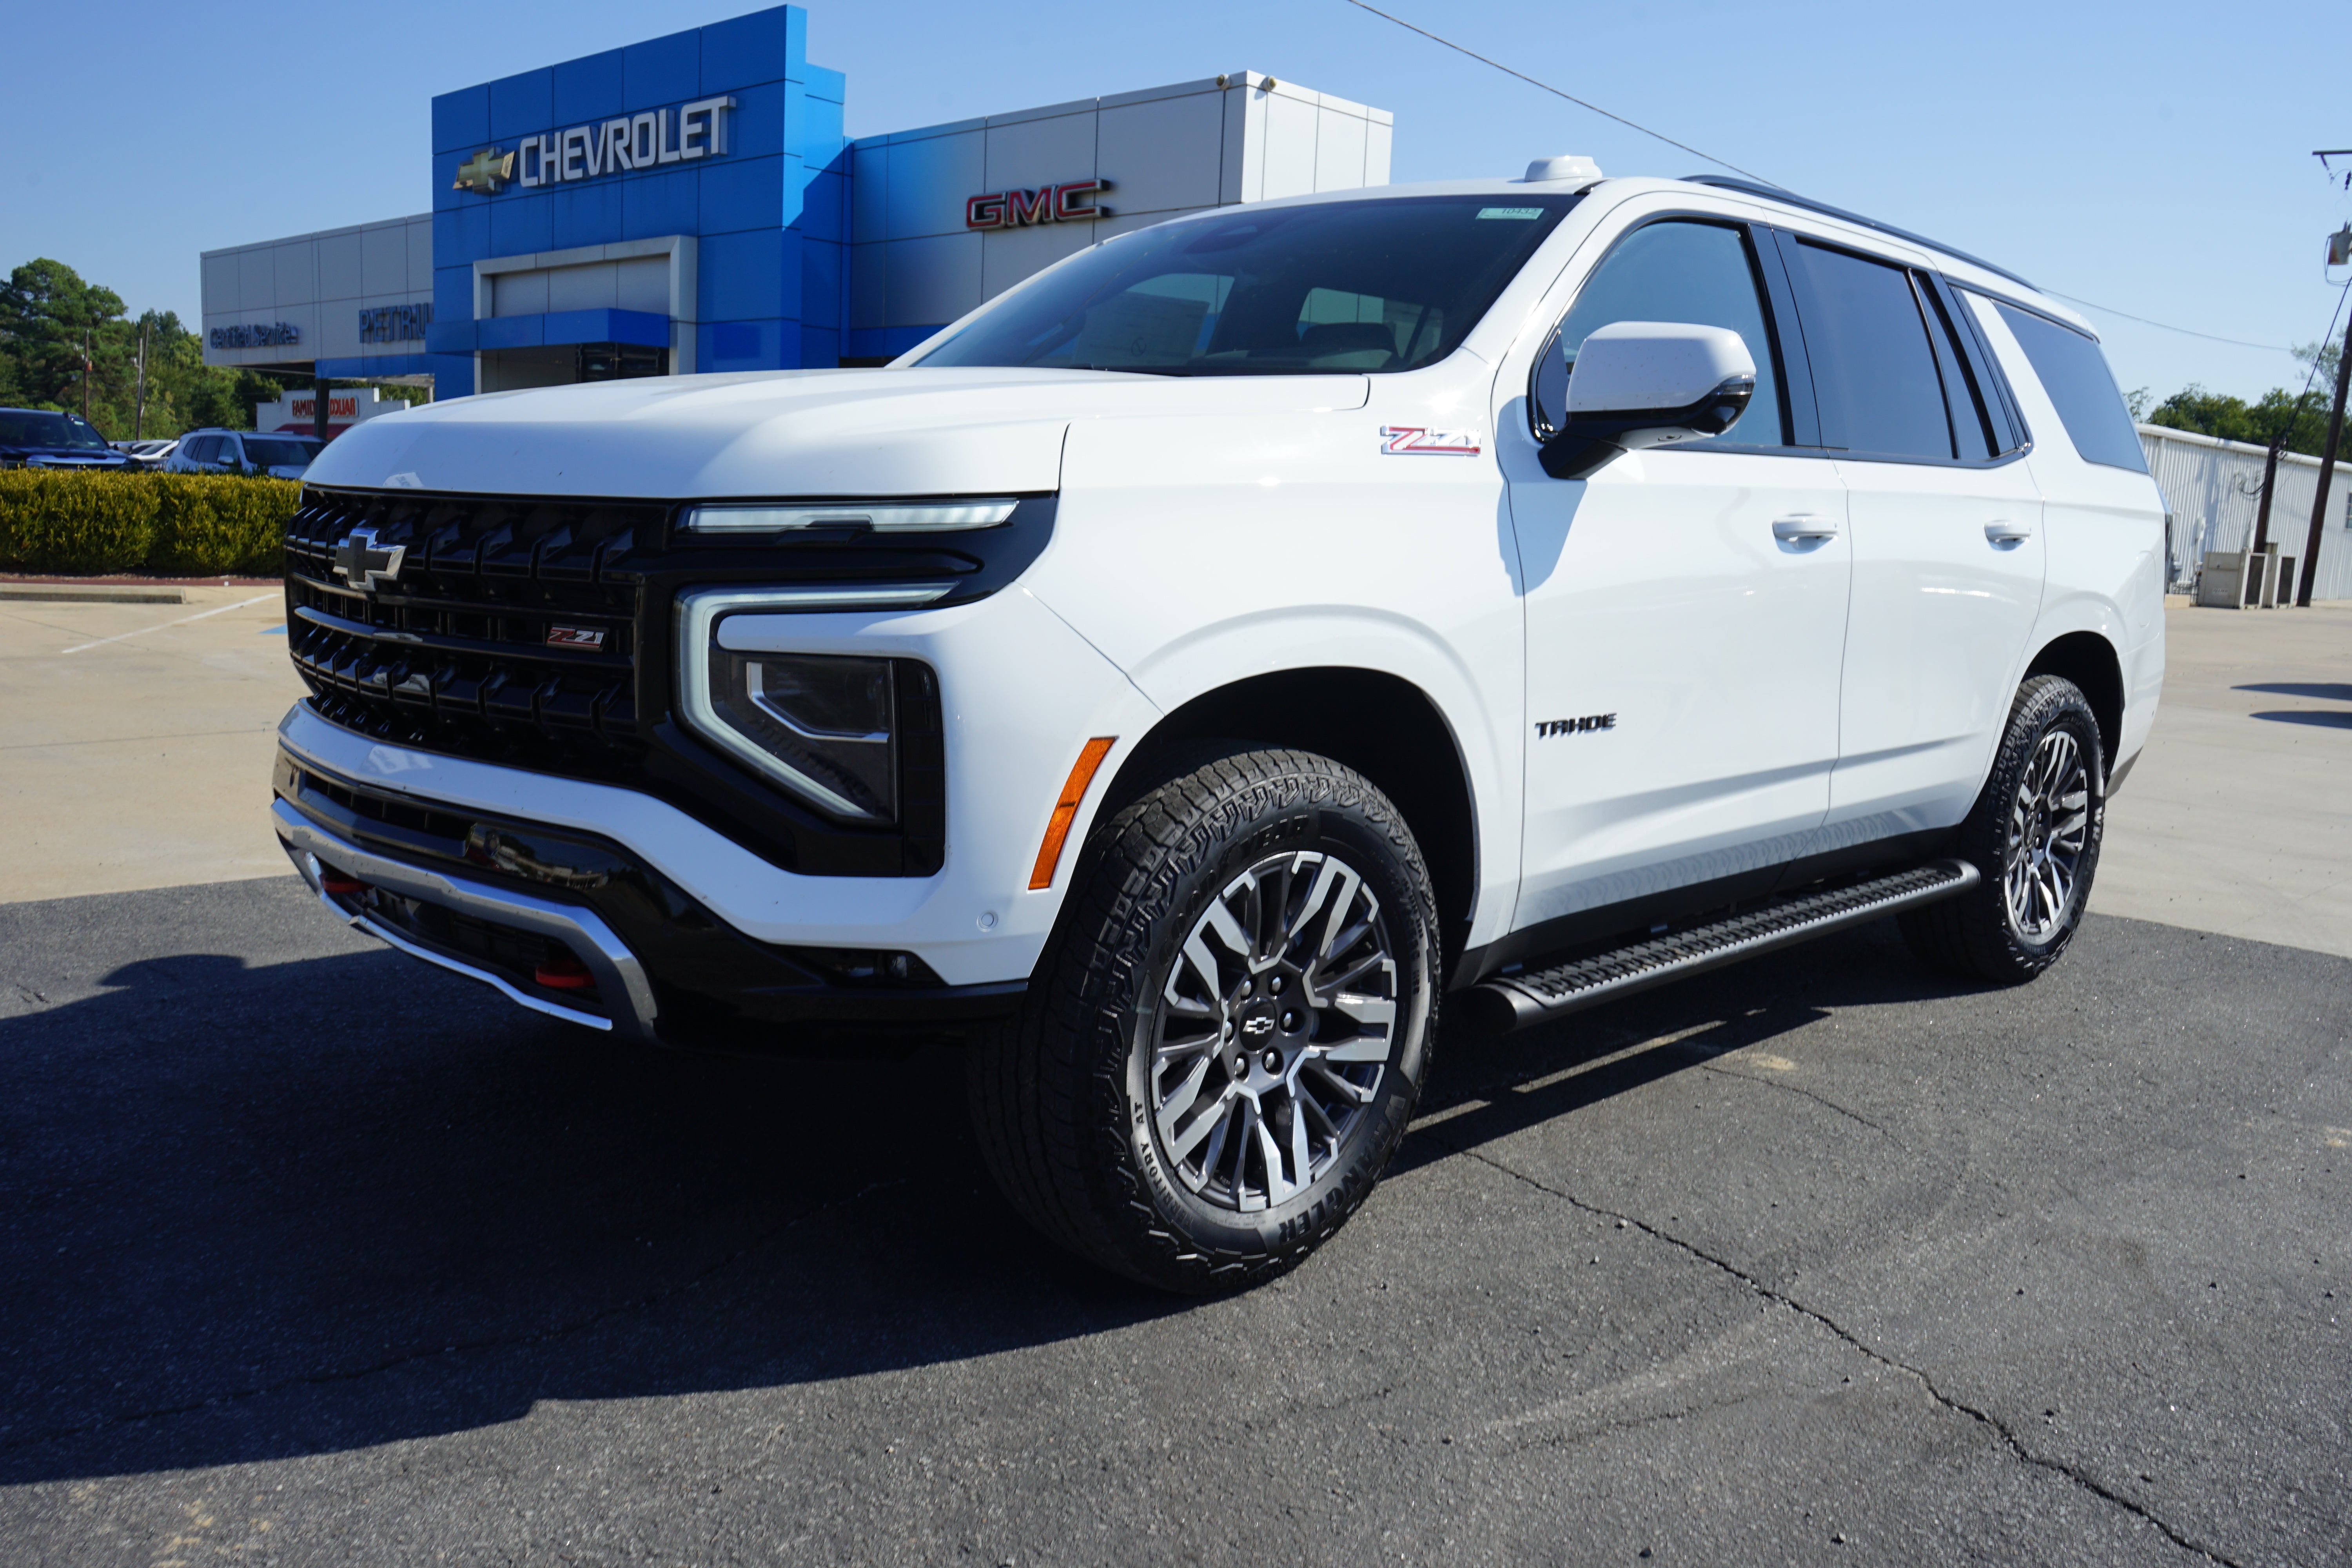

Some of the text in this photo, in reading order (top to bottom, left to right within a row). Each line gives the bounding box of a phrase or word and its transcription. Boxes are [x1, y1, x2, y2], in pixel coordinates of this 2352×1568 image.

[519, 96, 737, 187] CHEVROLET
[966, 178, 1110, 230] GMC
[254, 322, 298, 346] Service
[359, 303, 434, 343] PETRU
[329, 397, 356, 416] DOLLAR
[1380, 425, 1481, 457] Z71
[547, 627, 604, 648] Z71
[1535, 713, 1617, 737] TAHOE
[1279, 1094, 1406, 1245] WRANGLER
